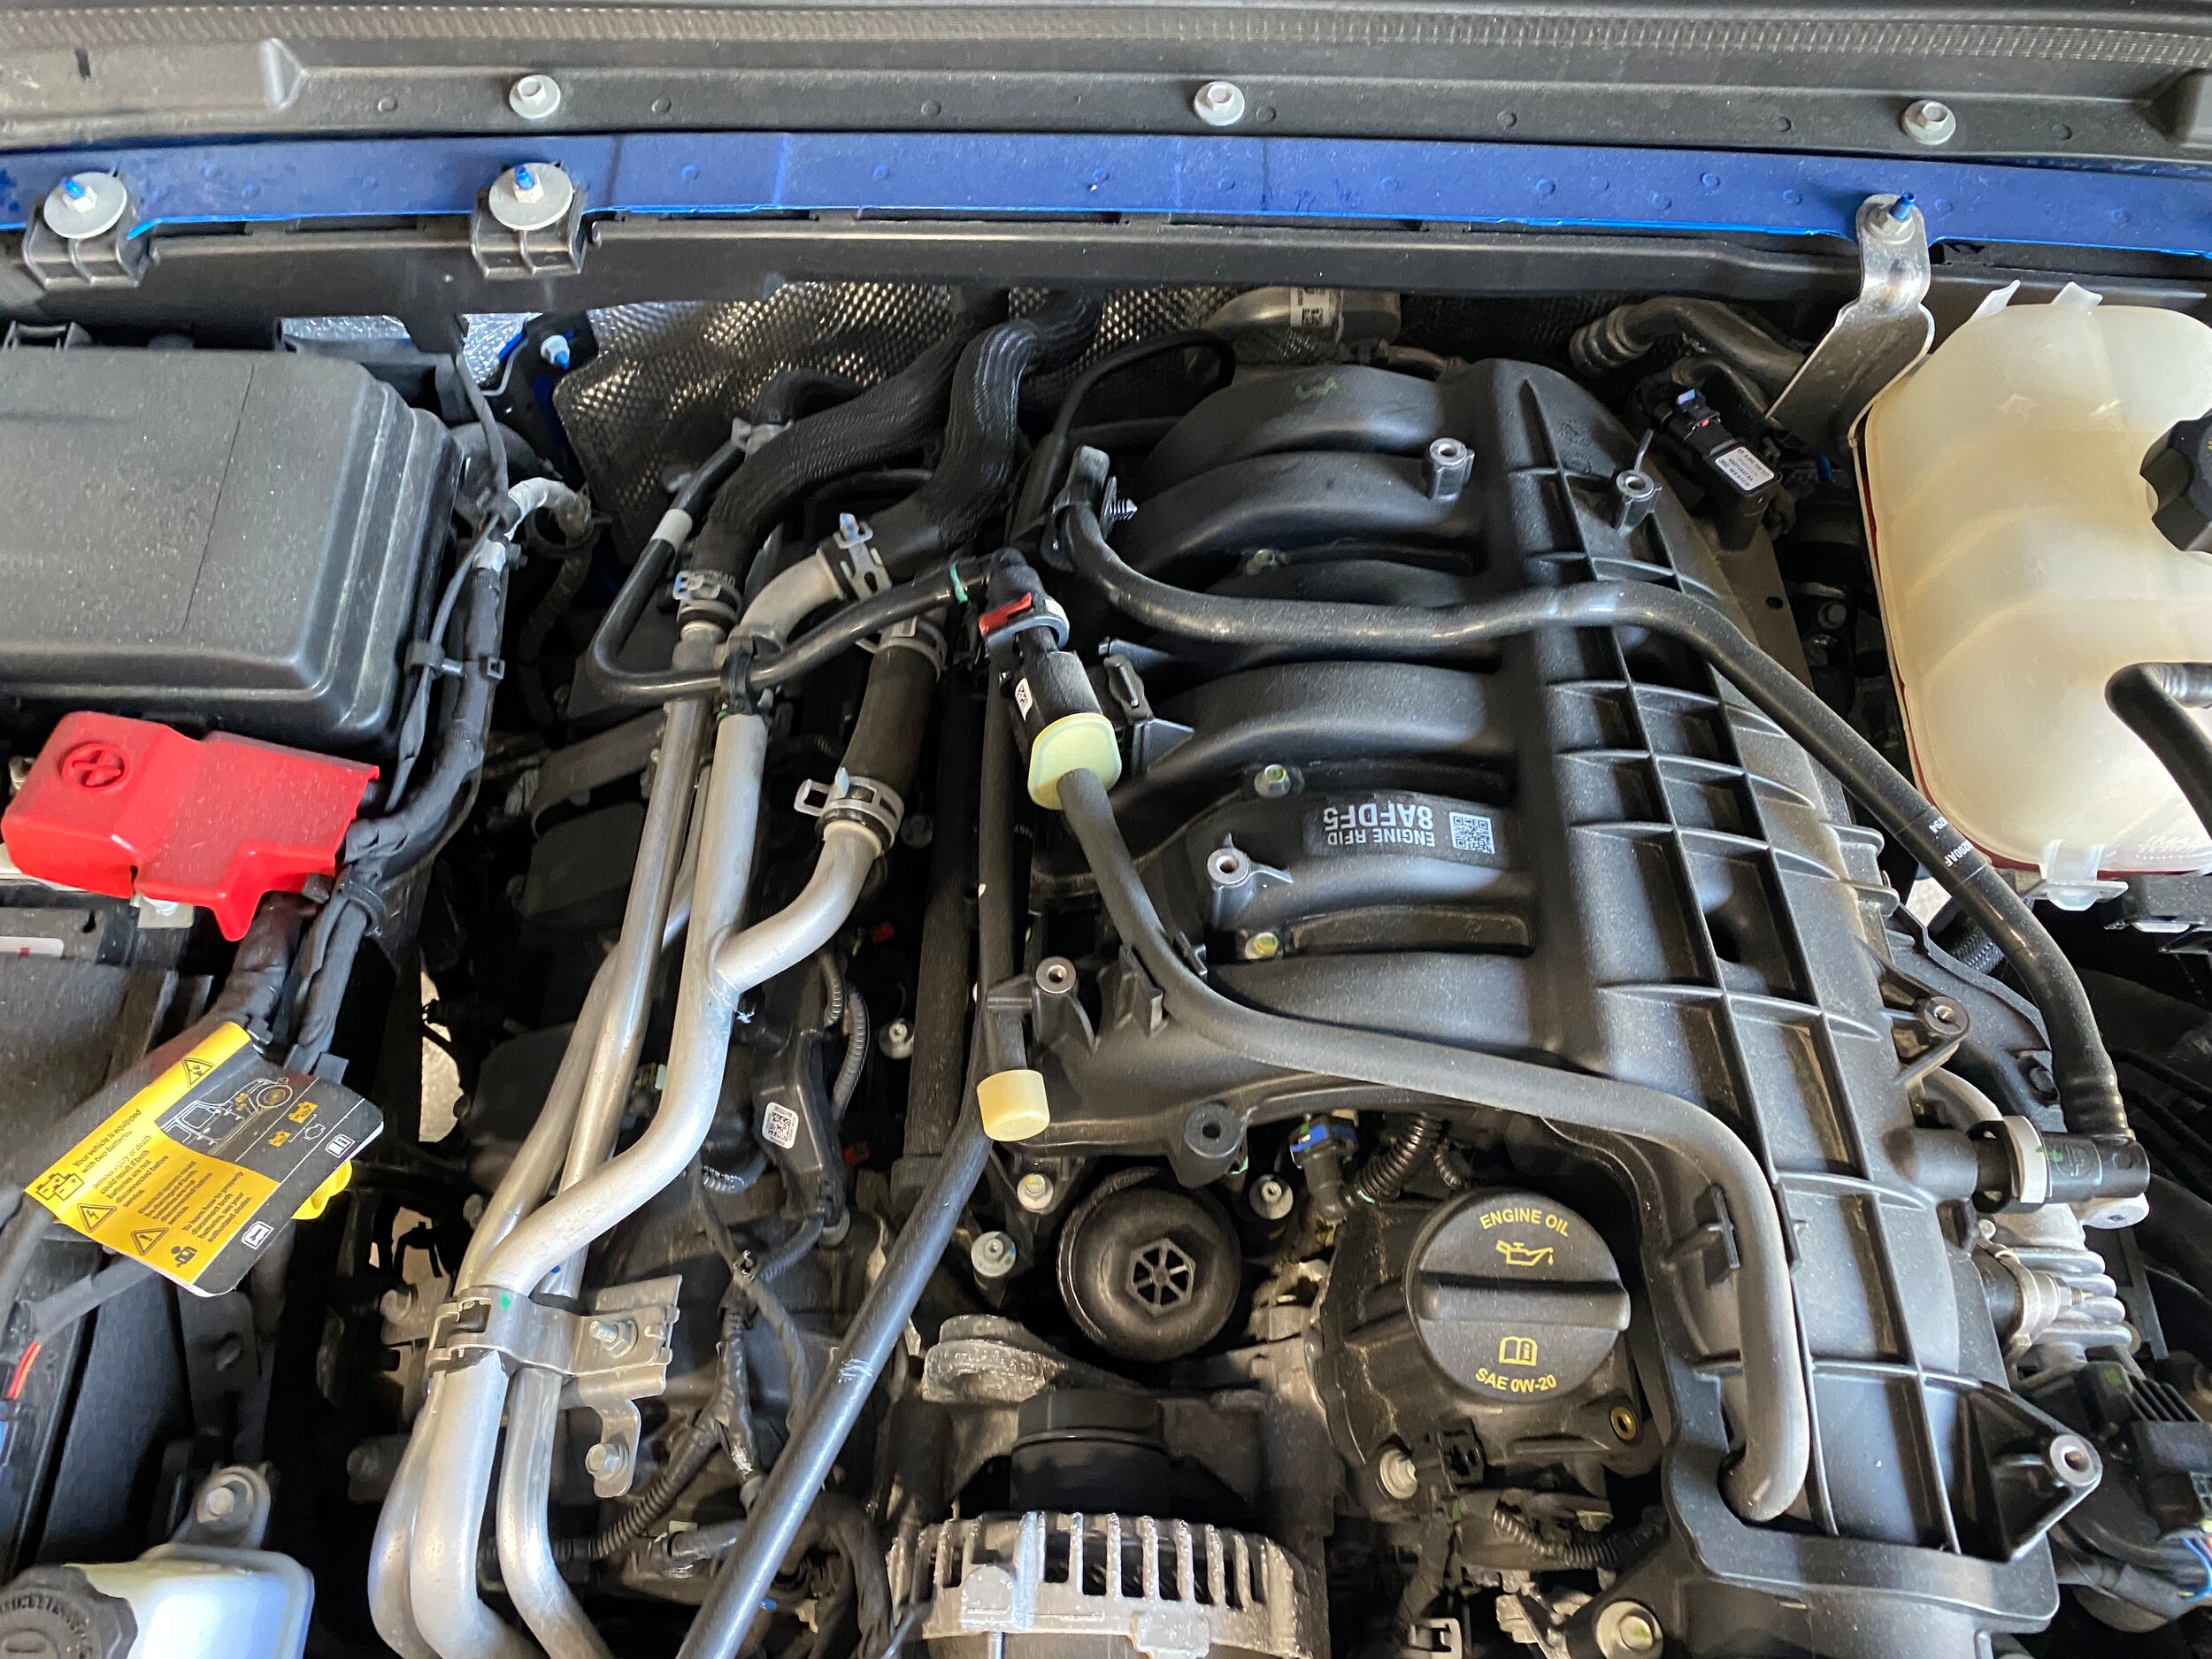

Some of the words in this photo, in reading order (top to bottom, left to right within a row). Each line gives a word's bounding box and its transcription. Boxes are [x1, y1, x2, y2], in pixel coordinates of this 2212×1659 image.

[1323, 803, 1433, 832] 8AFDF5
[1327, 828, 1366, 846] RFID
[1373, 828, 1435, 847] ENGINE
[72, 1154, 88, 1166] Your
[86, 1135, 110, 1156] vehicle
[113, 1109, 141, 1133] equipped
[81, 1159, 96, 1173] with
[94, 1149, 107, 1162] two
[105, 1129, 133, 1152] batteries.
[134, 1134, 151, 1150] death
[99, 1179, 116, 1194] could
[116, 1164, 132, 1179] result
[134, 1149, 150, 1162] both
[105, 1177, 132, 1198] batteries
[132, 1168, 141, 1177] are
[140, 1159, 150, 1169] not
[115, 1170, 151, 1202] disconnected
[149, 1155, 168, 1171] before
[184, 1179, 196, 1189] not
[189, 1210, 204, 1224] learn
[202, 1198, 216, 1210] how
[221, 1171, 242, 1193] properly
[222, 1203, 232, 1214] see
[231, 1192, 243, 1204] your
[144, 1208, 155, 1217] be
[190, 1205, 219, 1234] disconnect
[218, 1194, 232, 1205] both
[208, 1213, 235, 1241] authorized
[1479, 1208, 1542, 1230] ENGINE
[1545, 1214, 1568, 1238] OIL
[1475, 1367, 1509, 1391] SAE
[1510, 1374, 1557, 1394] 0W-20
